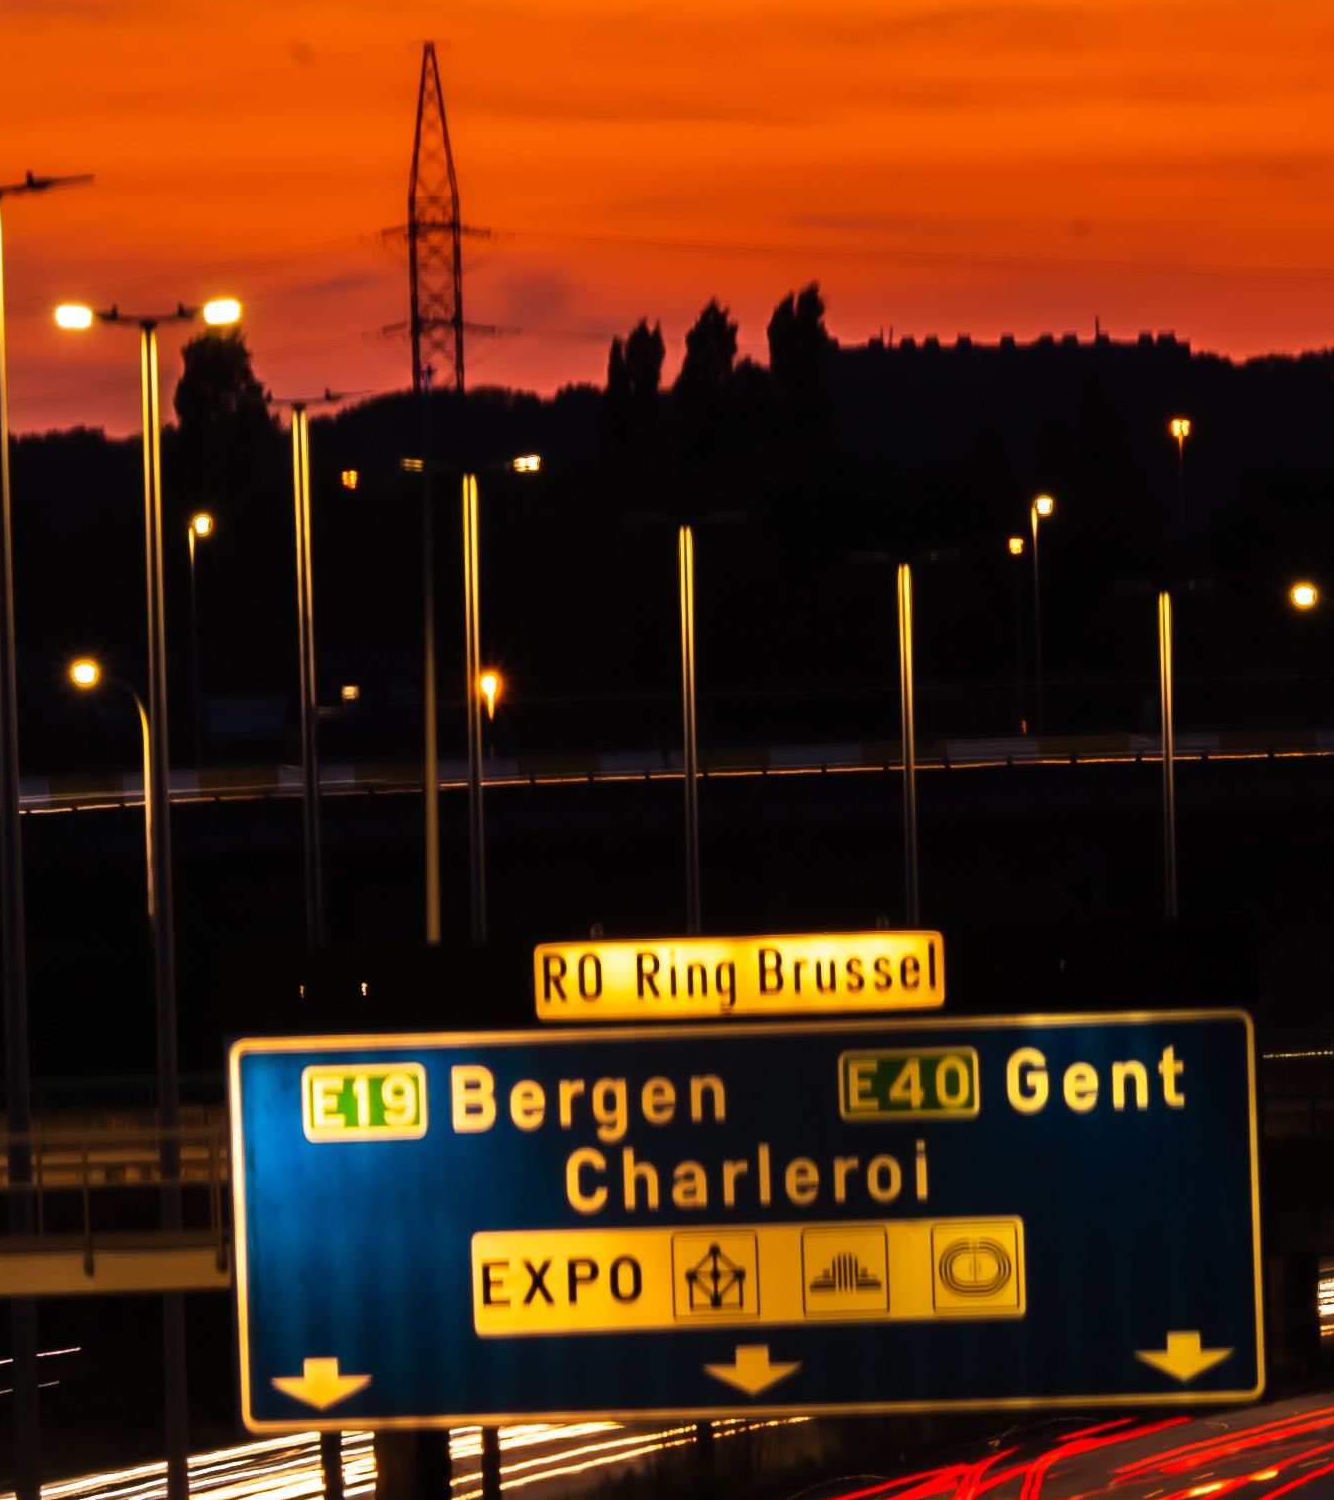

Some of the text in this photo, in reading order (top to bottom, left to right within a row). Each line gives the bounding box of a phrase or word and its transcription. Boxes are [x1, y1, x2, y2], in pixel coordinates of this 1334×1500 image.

[636, 952, 737, 1014] Ring
[757, 939, 937, 996] Brussel
[312, 1064, 726, 1144] E19 Bergen
[848, 1045, 1186, 1115] E40 Gent
[566, 1138, 928, 1215] Charleroi
[480, 1256, 644, 1311] EXPO
